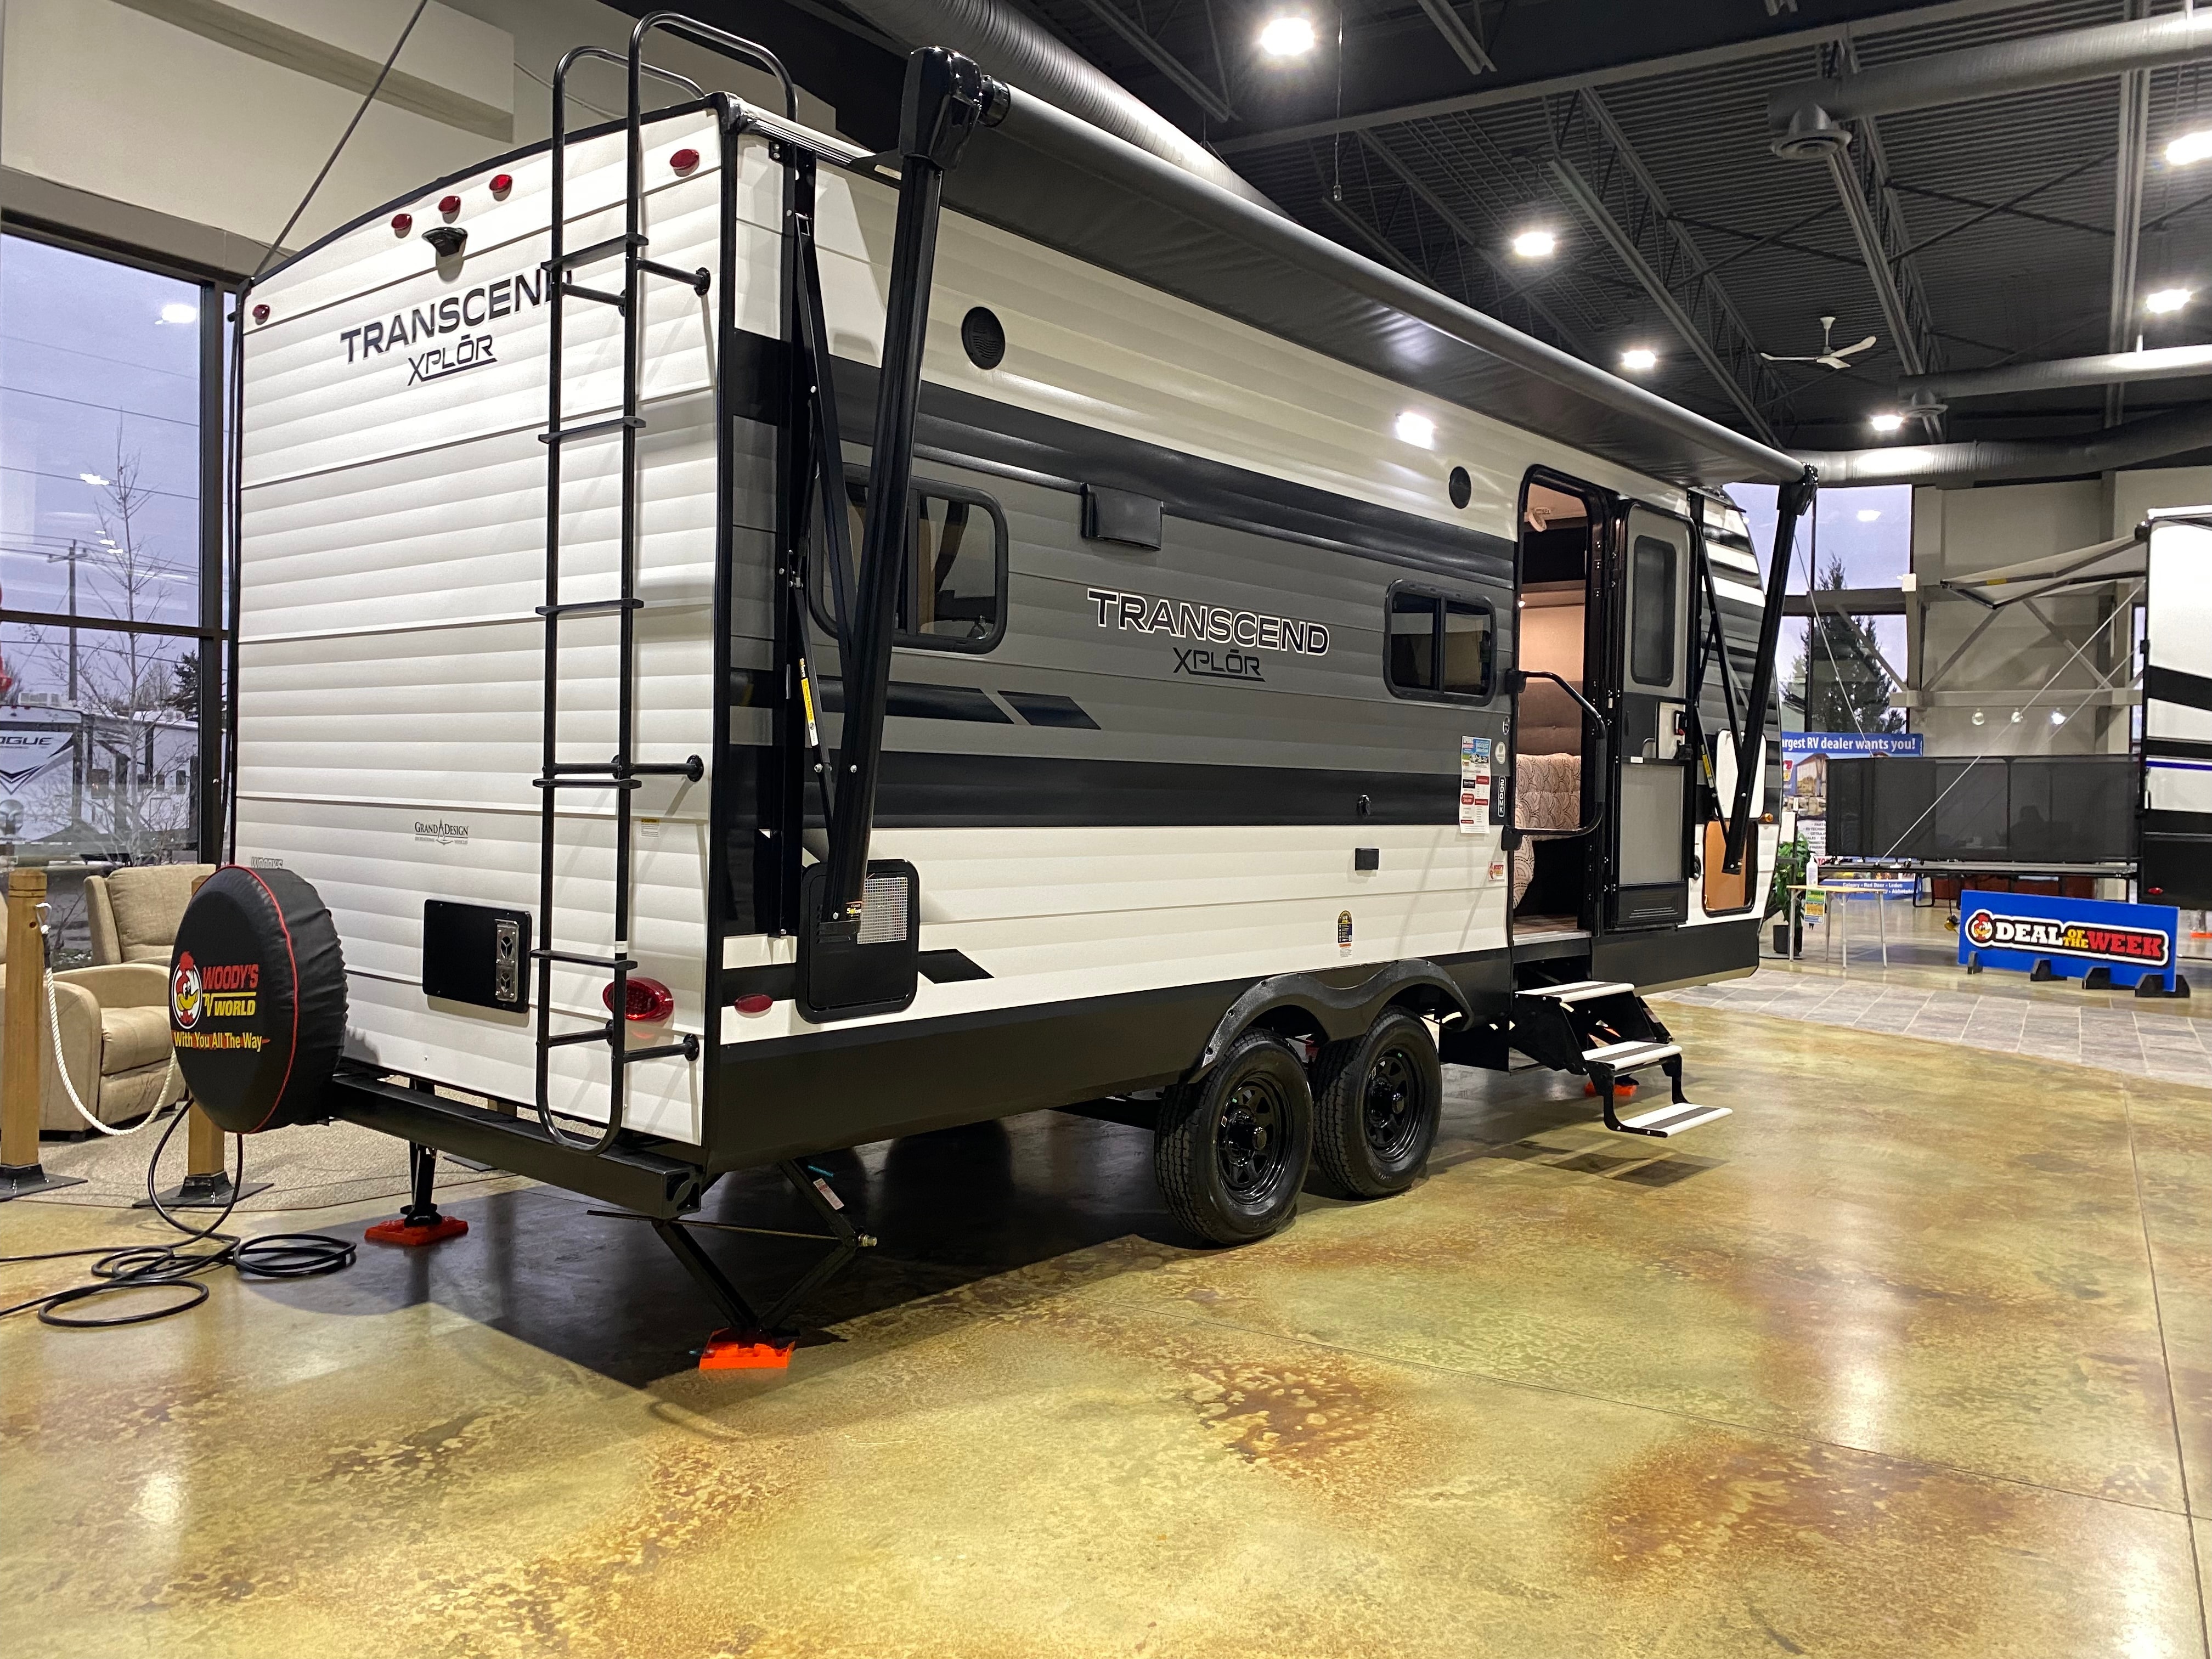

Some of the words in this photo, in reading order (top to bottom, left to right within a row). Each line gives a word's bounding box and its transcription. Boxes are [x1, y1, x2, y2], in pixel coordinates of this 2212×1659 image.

[1087, 588, 1330, 656] TRANSCEND
[1807, 737, 1819, 749] RV
[1821, 737, 1853, 750] dealer
[1855, 740, 1888, 750] wants
[1891, 738, 1915, 752] you!
[1996, 922, 2062, 946] DEAL
[2067, 929, 2085, 939] OF
[2087, 931, 2162, 957] WEEK
[2062, 939, 2089, 949] THE
[203, 964, 259, 990] WOODY'S
[215, 1000, 256, 1016] WORLD
[174, 1031, 193, 1047] With
[194, 1032, 210, 1047] You
[212, 1032, 223, 1048] All
[224, 1032, 241, 1048] The
[242, 1031, 262, 1052] Way
